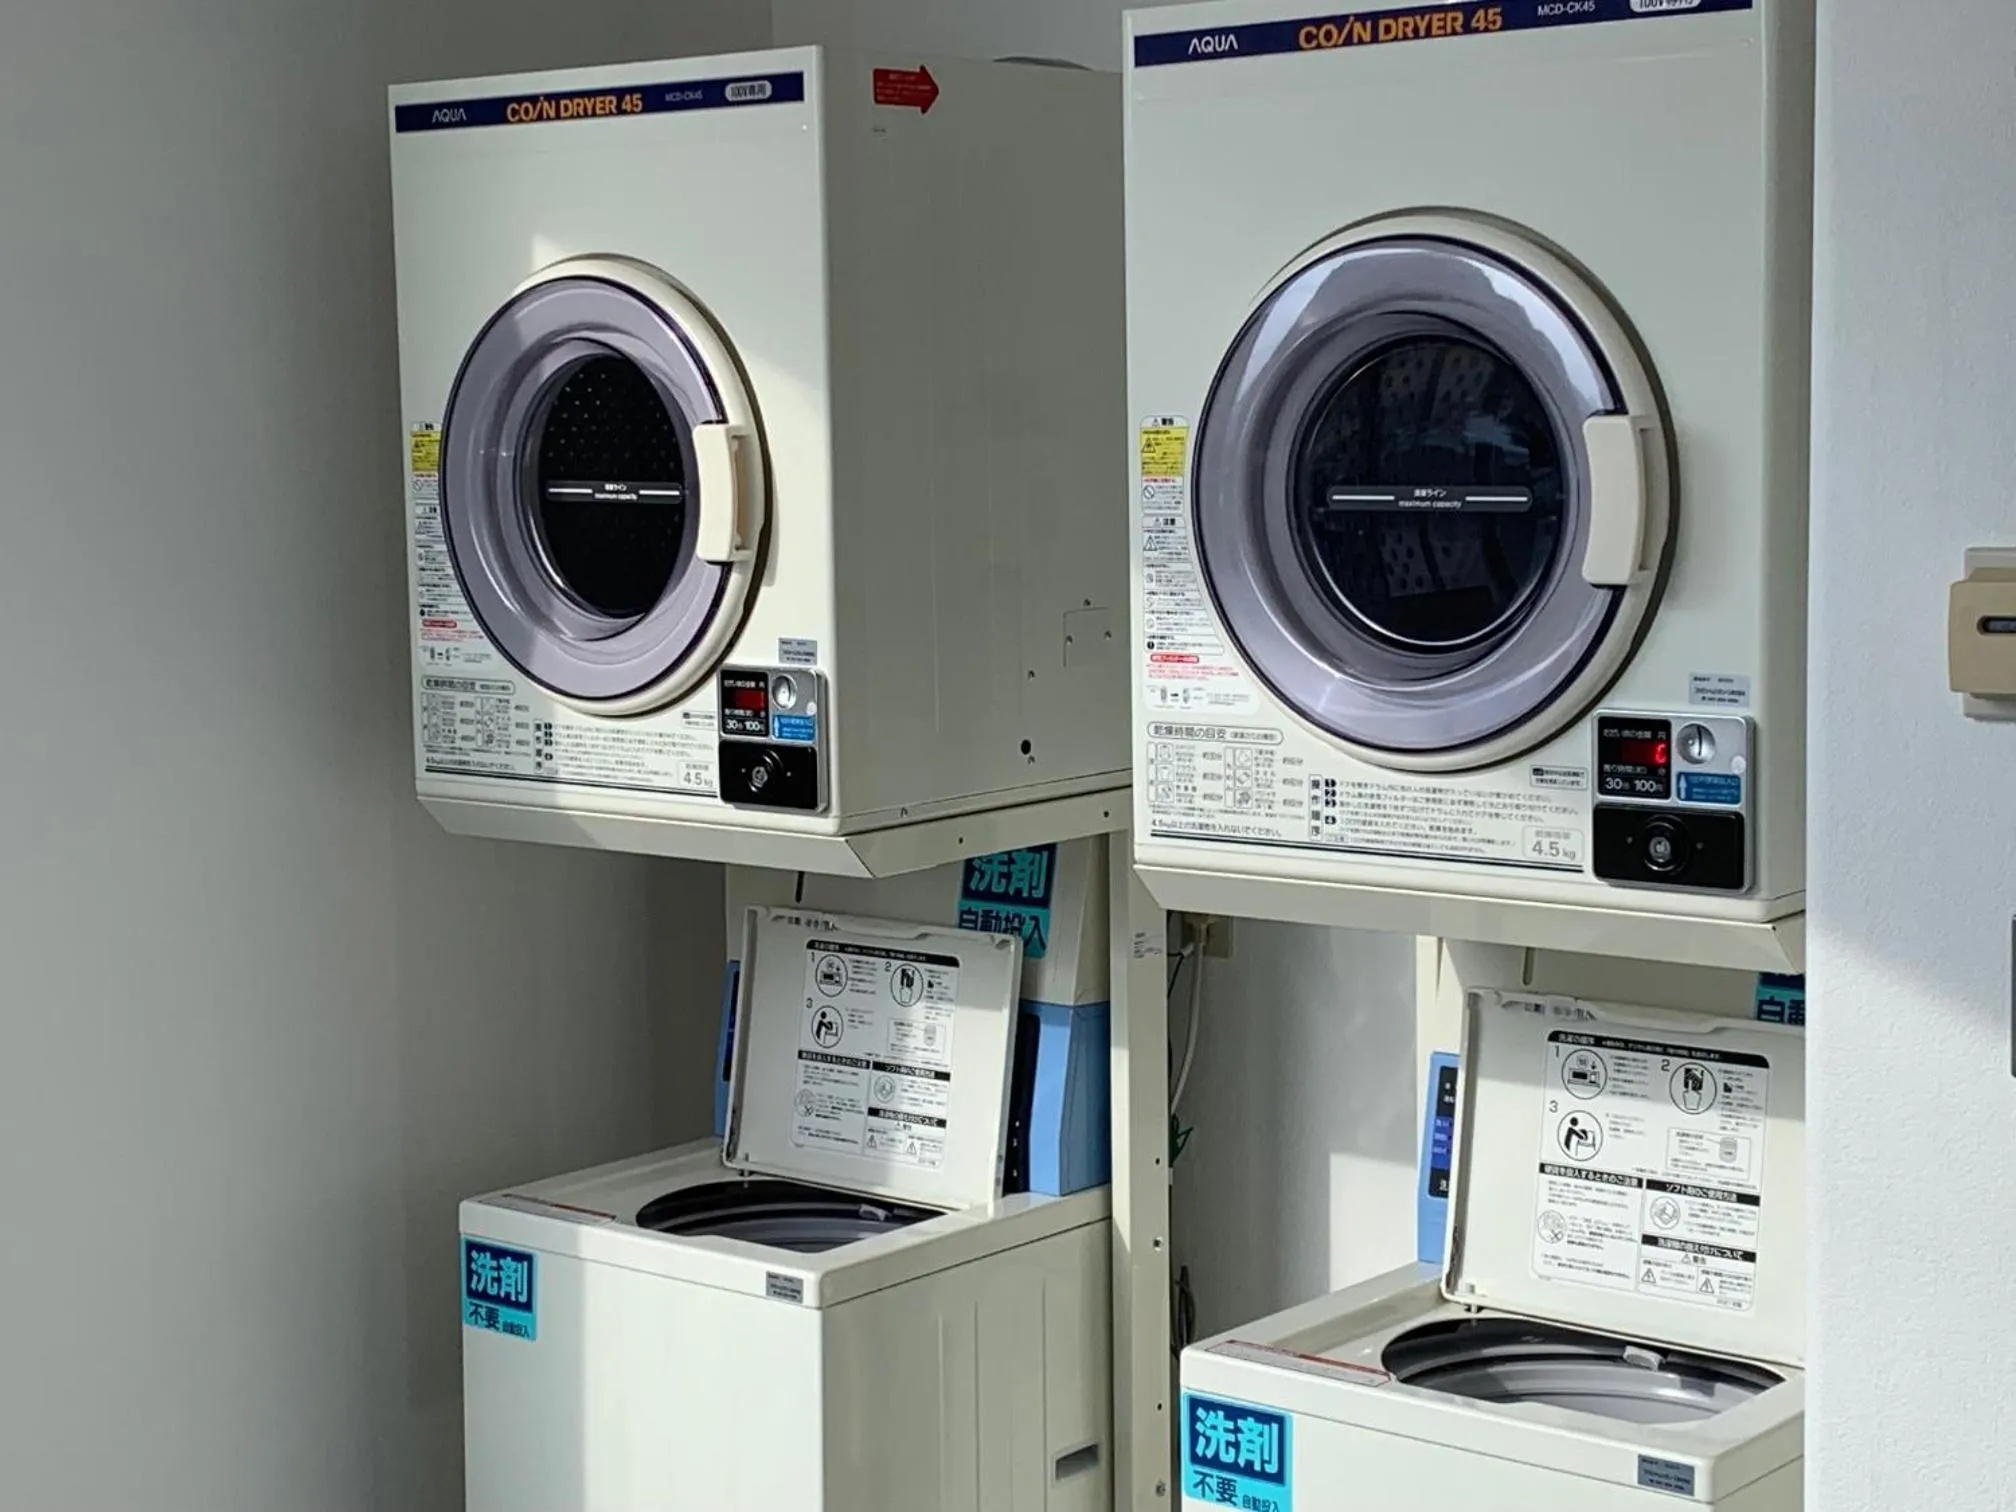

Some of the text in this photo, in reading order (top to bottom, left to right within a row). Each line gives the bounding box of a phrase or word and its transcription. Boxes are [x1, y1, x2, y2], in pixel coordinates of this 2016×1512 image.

[1378, 12, 1465, 44] DRYER
[1470, 6, 1503, 32] 45
[1188, 34, 1239, 55] AQUA
[431, 108, 467, 123] AQUA
[560, 95, 618, 119] DRYER
[621, 92, 644, 114] 45
[969, 849, 1048, 898] 洗剤
[1660, 1059, 1671, 1072] 2
[1548, 1100, 1559, 1113] 3
[471, 1251, 529, 1303] 洗剤
[468, 1302, 500, 1331] 不要
[1195, 1407, 1279, 1474] 洗剤
[1192, 1469, 1238, 1507] 不要
